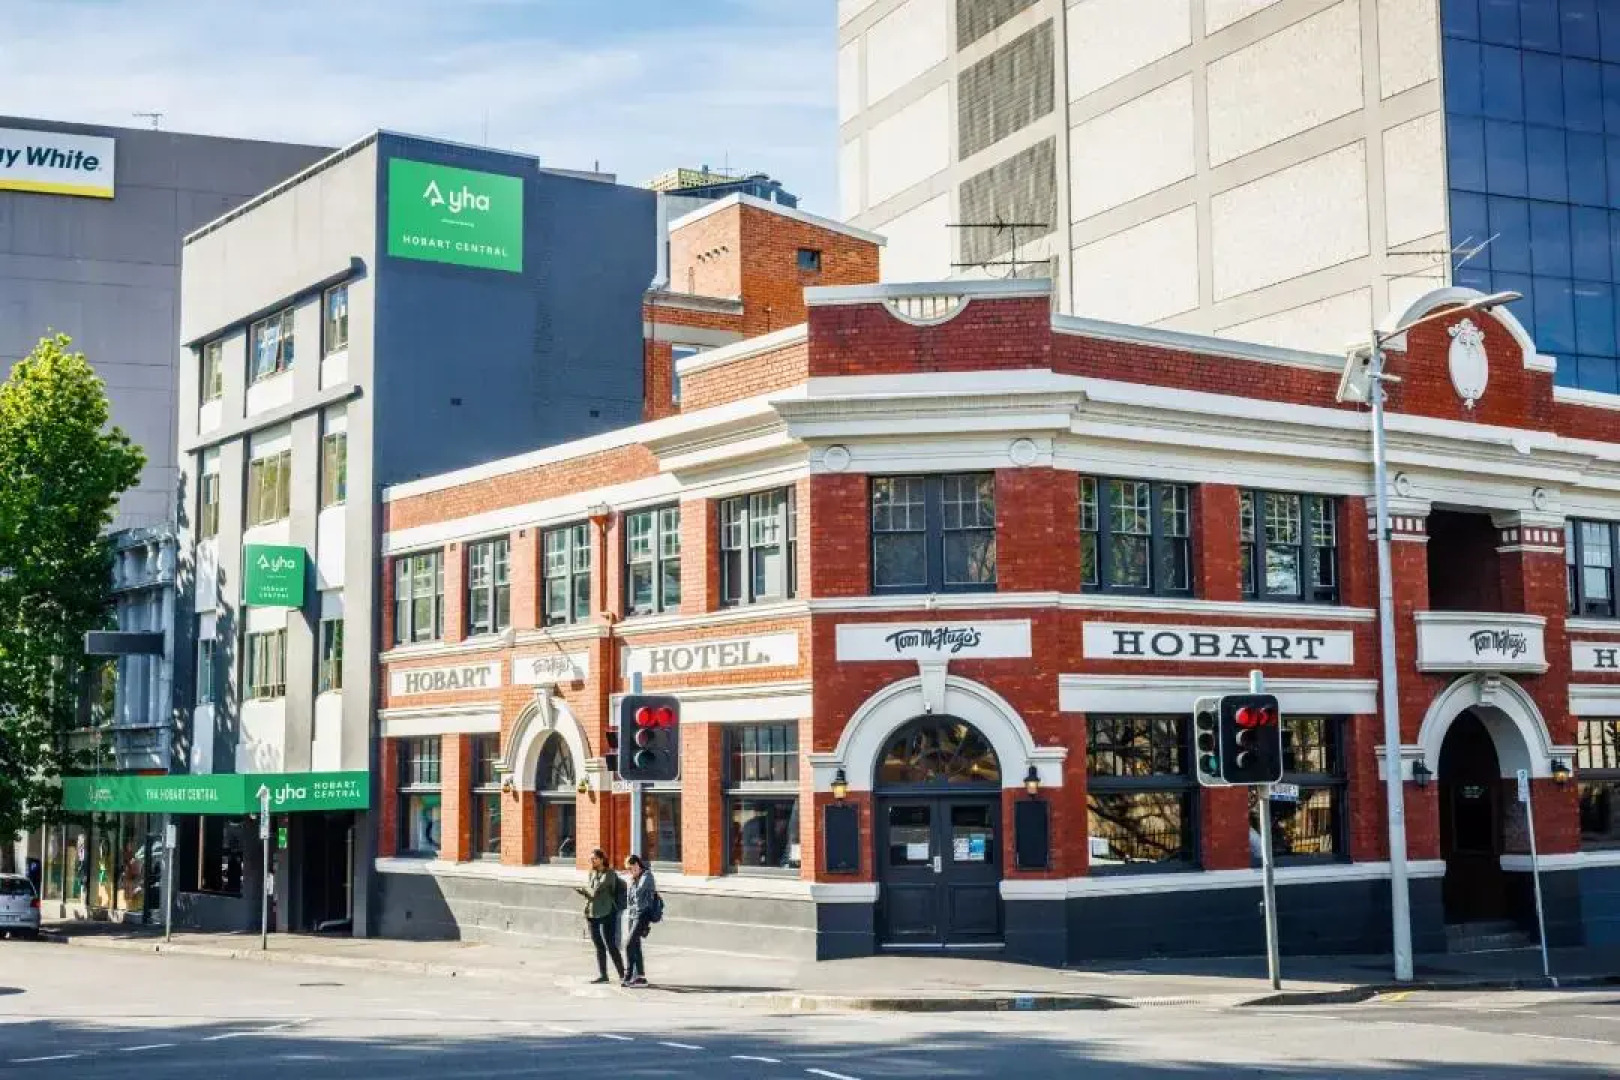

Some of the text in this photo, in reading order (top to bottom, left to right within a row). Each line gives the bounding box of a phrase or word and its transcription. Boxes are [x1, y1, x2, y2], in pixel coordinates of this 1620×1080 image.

[448, 185, 490, 213] yha
[402, 234, 508, 258] HOBART CENTRAL
[885, 629, 918, 652] Tom
[1112, 630, 1325, 660] HOBART
[404, 666, 491, 694] HOBART
[275, 782, 307, 805] yha
[313, 780, 357, 790] HOBART
[314, 789, 361, 799] CENTRAL
